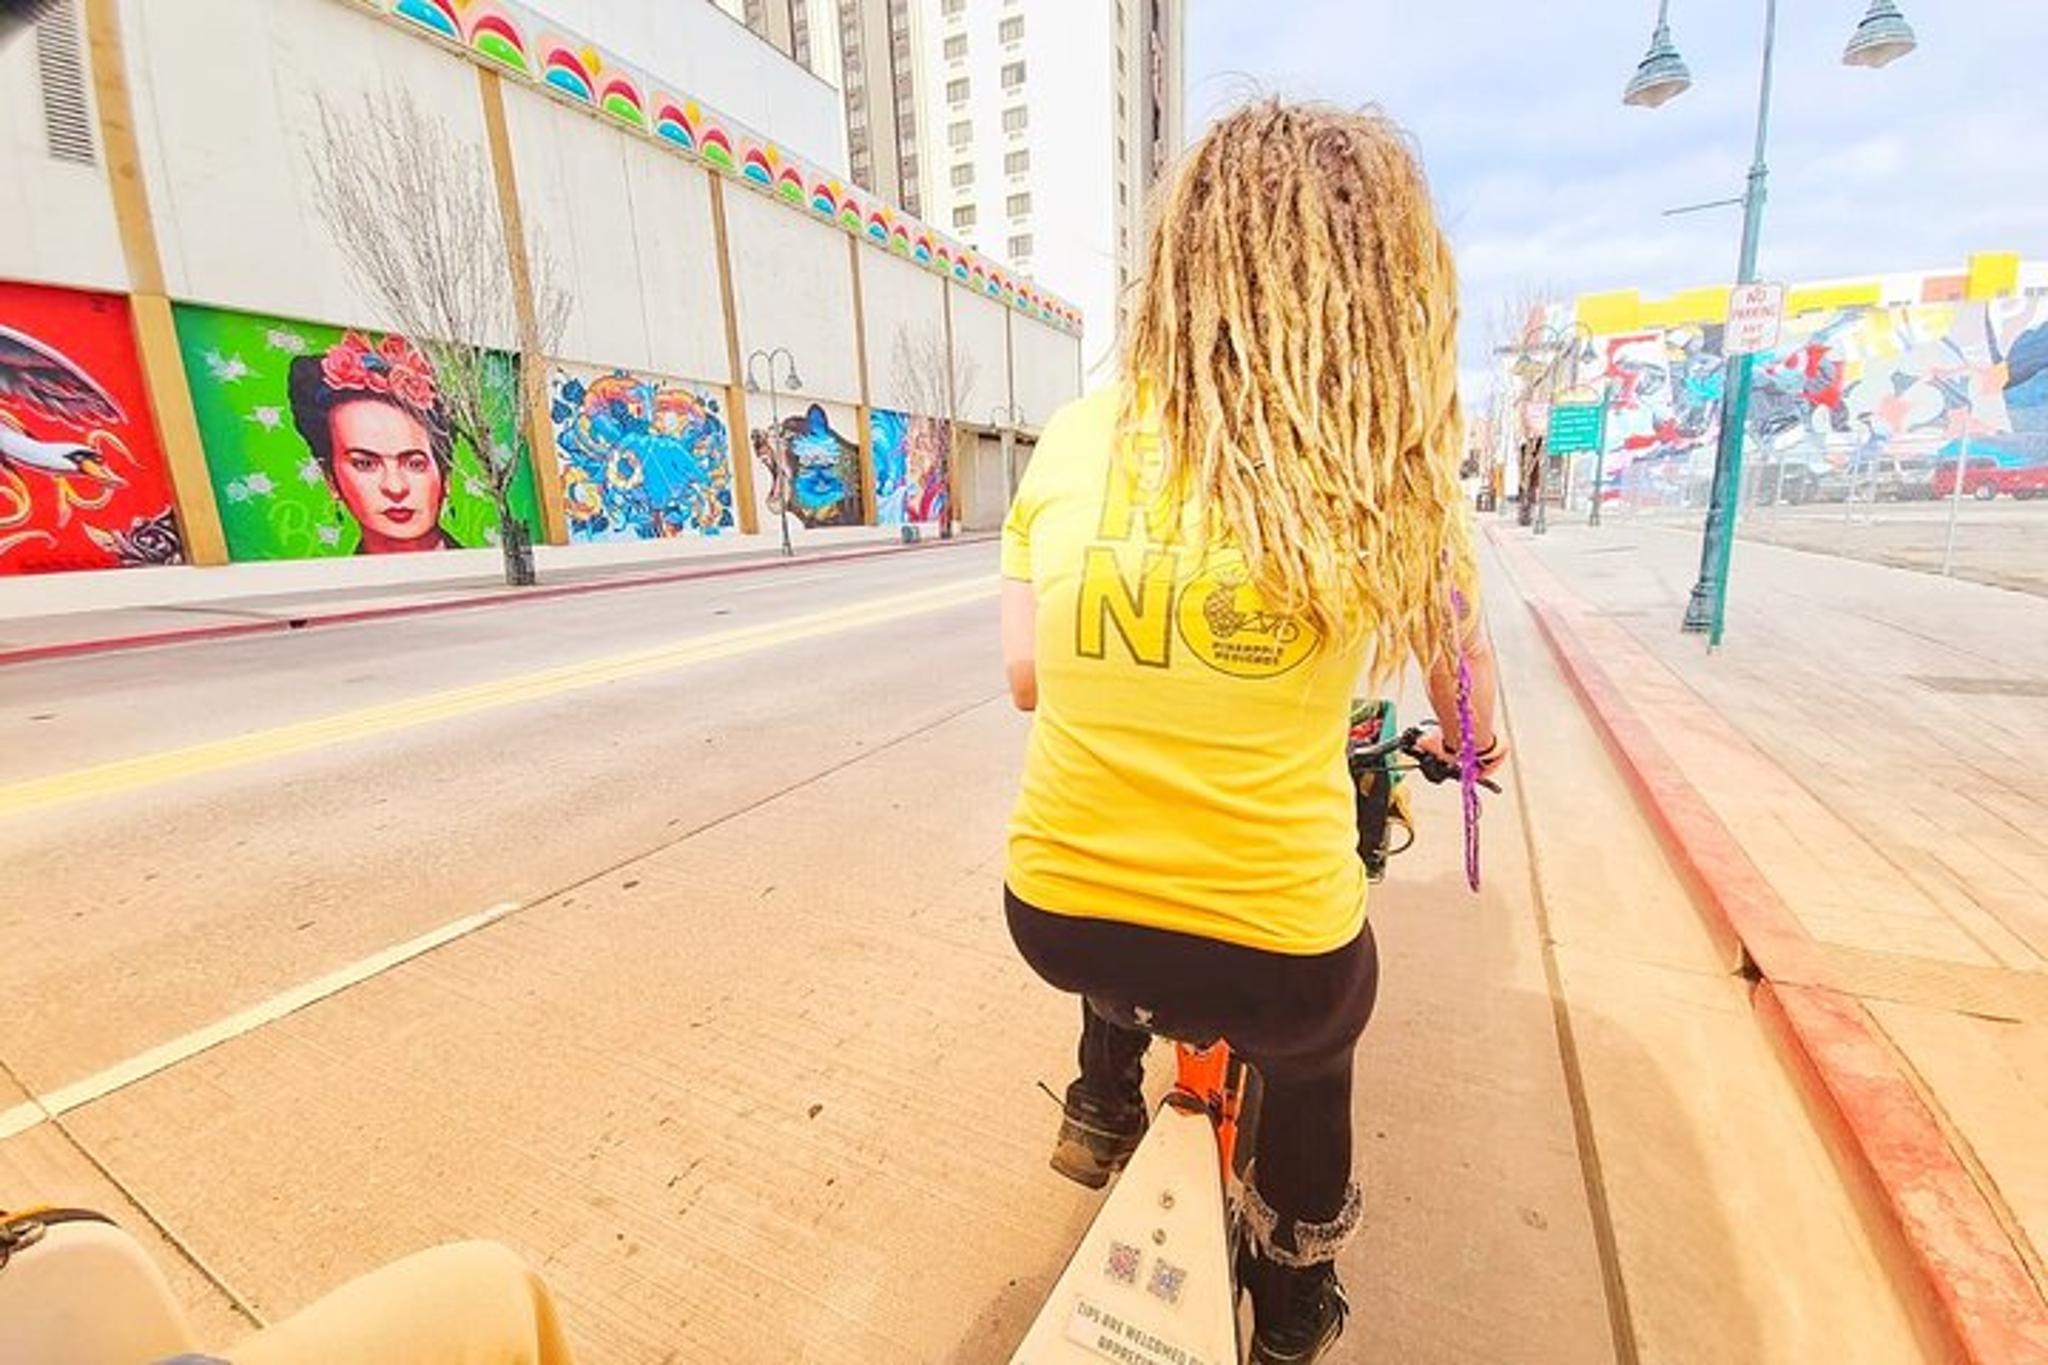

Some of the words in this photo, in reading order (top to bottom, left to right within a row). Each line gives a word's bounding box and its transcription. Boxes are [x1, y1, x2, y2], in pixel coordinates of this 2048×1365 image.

[1746, 286, 1767, 304] NO
[1077, 1301, 1101, 1323] TIPS
[1101, 1313, 1124, 1335] ARE
